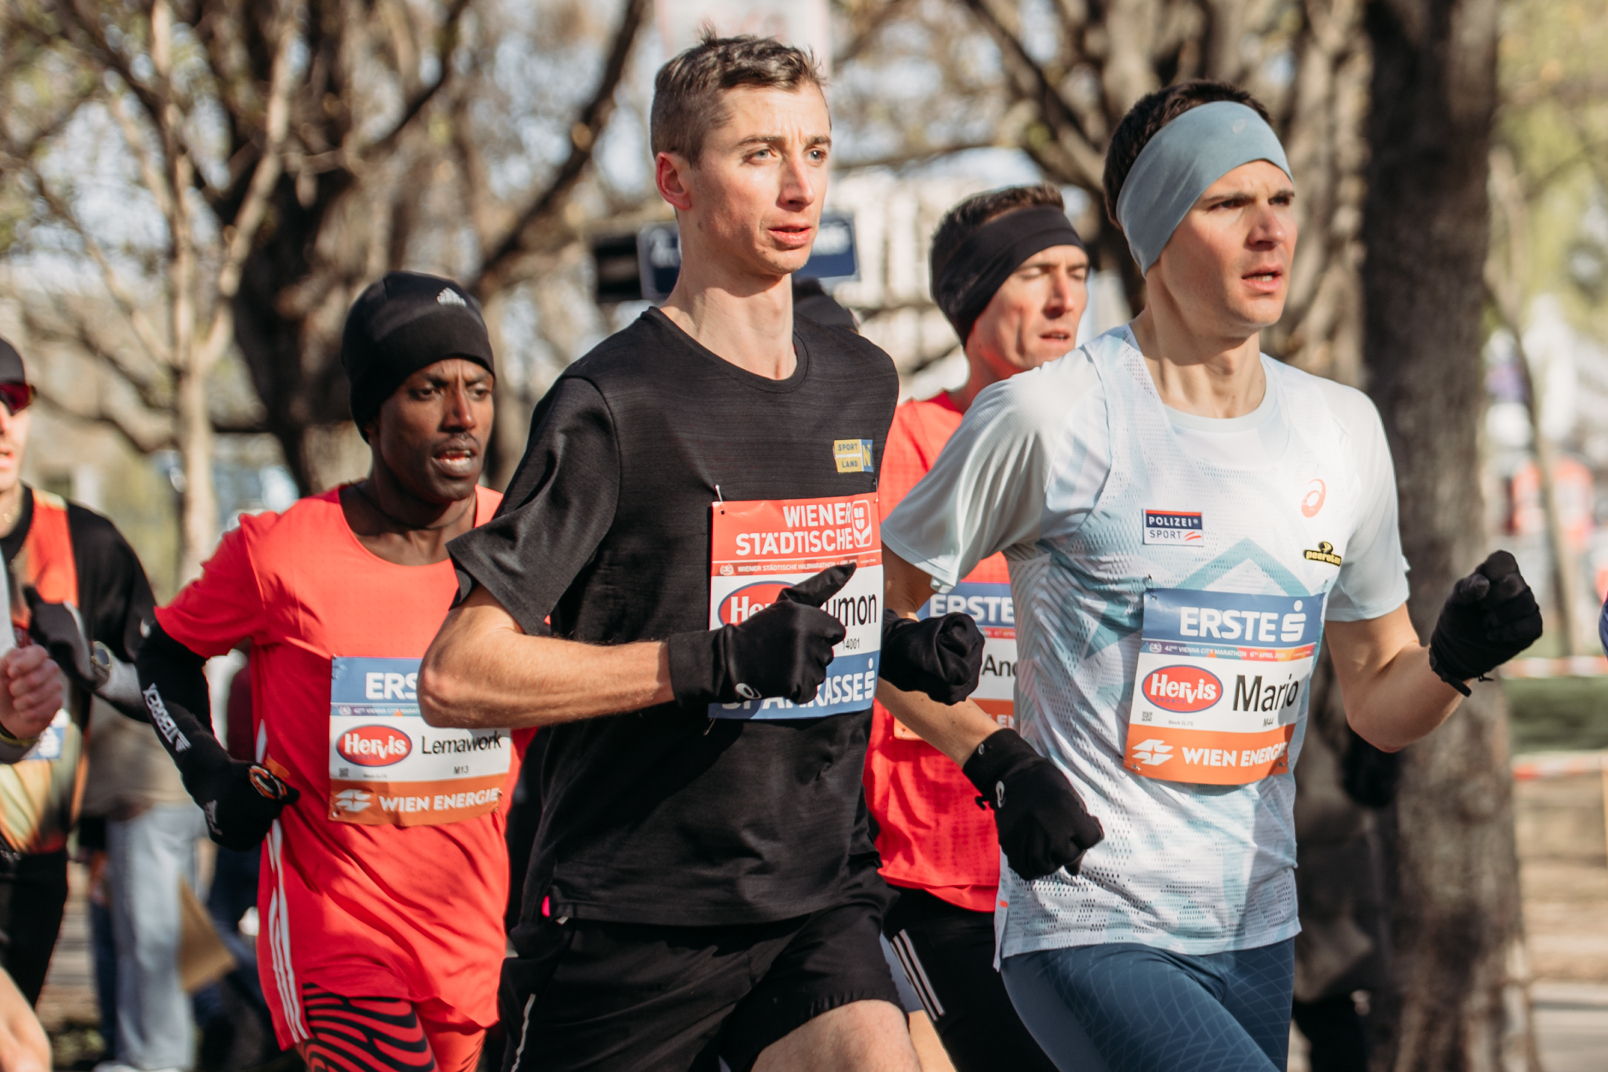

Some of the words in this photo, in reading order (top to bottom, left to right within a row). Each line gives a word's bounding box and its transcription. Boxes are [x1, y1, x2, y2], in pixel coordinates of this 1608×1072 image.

[838, 443, 858, 451] SPORT
[841, 460, 859, 468] LAND
[783, 502, 851, 528] WIENER
[1148, 516, 1192, 527] POLIZEI
[735, 527, 853, 556] STÄDTISCHE
[1149, 530, 1181, 539] SPORT
[826, 593, 877, 626] umon
[930, 593, 1015, 624] ERSTE
[1179, 606, 1279, 643] ERSTE
[1178, 646, 1200, 654] VIENNA
[1214, 648, 1247, 658] MARATHON
[365, 672, 418, 700] ERS
[1150, 673, 1217, 704] Hervis
[1232, 673, 1299, 712] Mario
[344, 732, 408, 760] Hervis
[421, 730, 502, 755] Lemawork
[1182, 746, 1237, 768] WIEN
[1240, 741, 1288, 767] ENERGIE
[453, 765, 469, 775] M13
[379, 795, 430, 813] WIEN
[433, 788, 500, 811] ENERGIE
